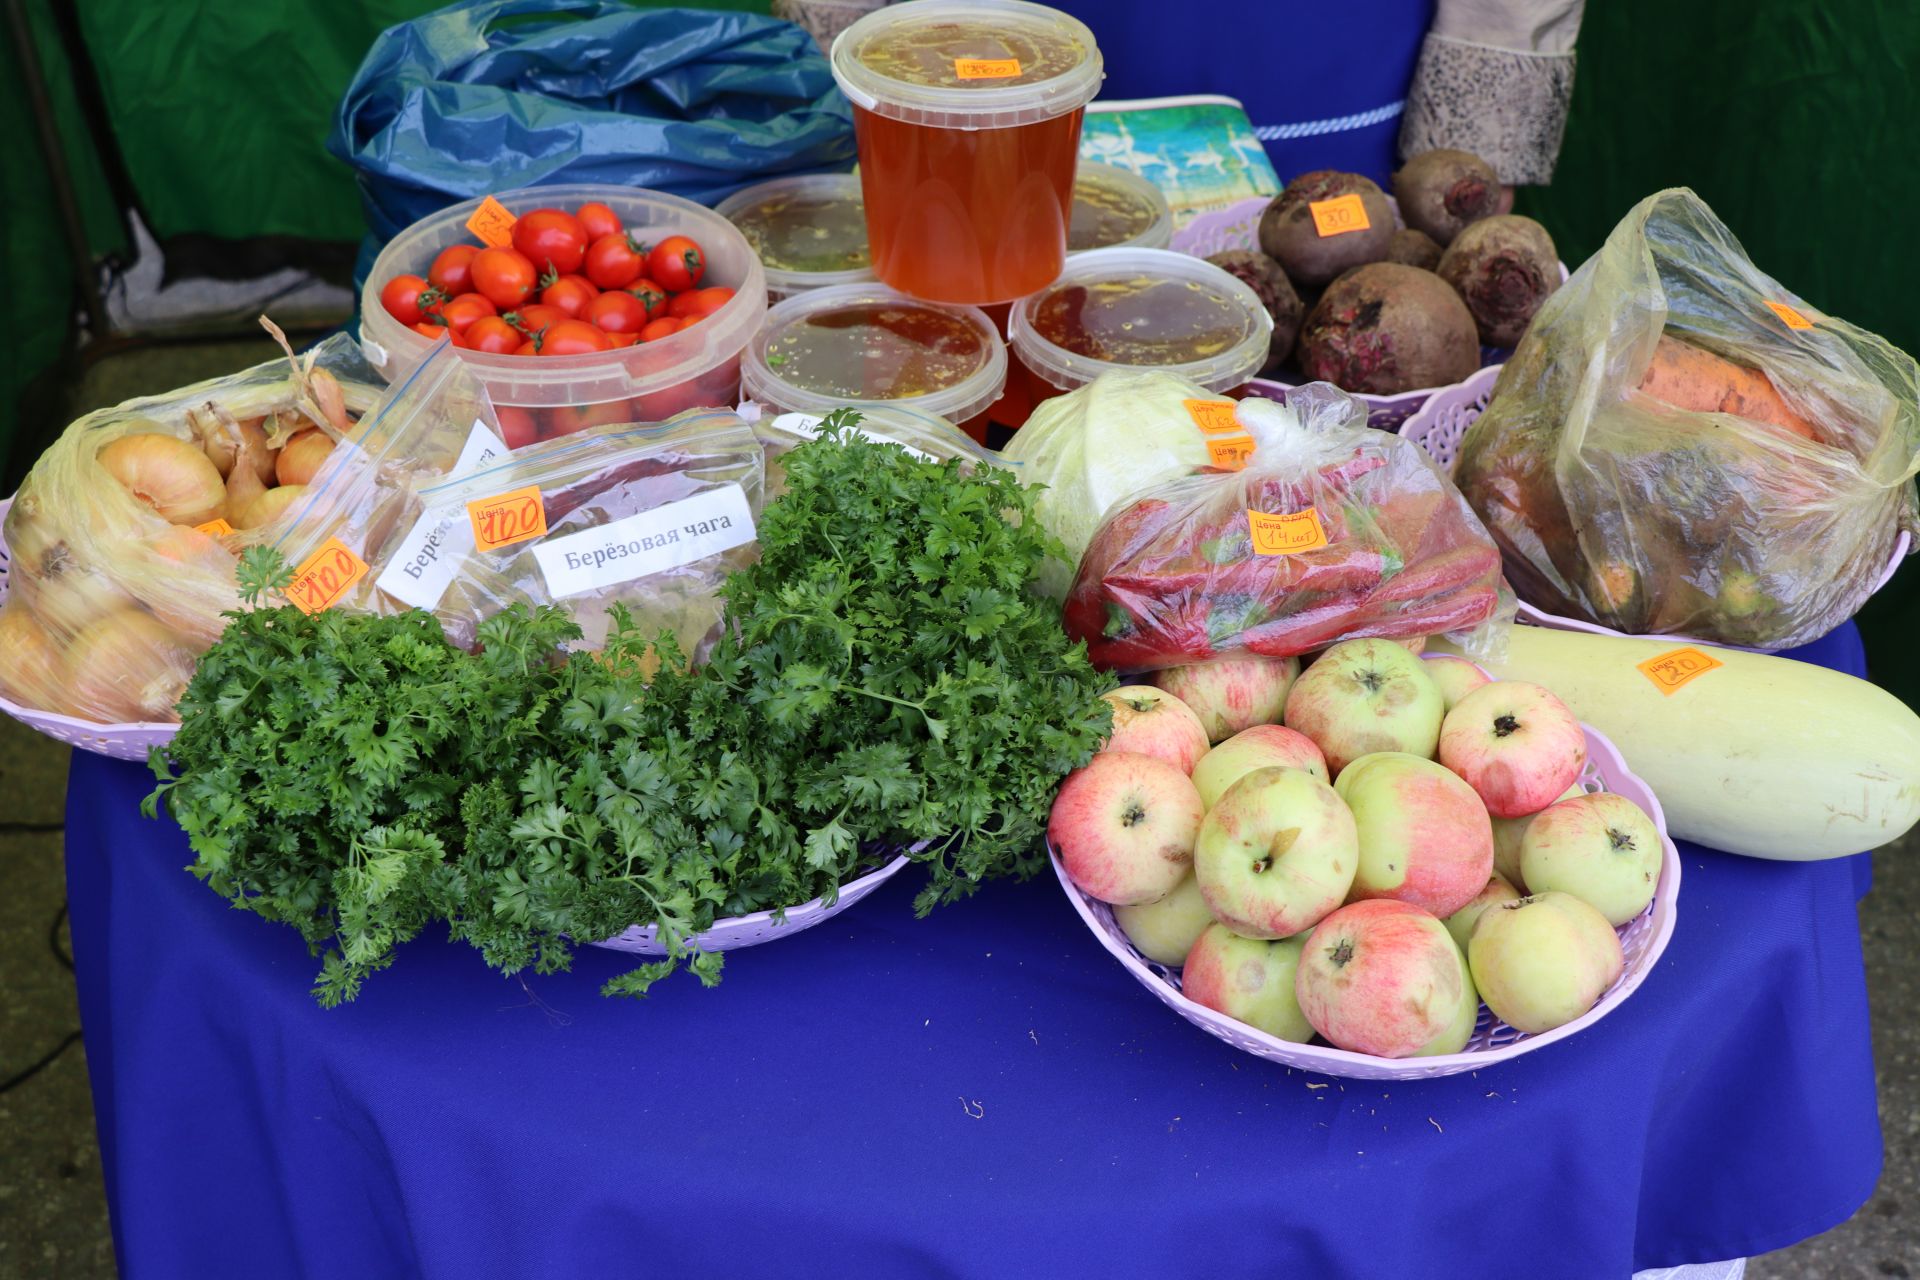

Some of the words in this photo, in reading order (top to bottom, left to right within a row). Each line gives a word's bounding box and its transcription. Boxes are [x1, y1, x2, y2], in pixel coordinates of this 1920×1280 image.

[477, 507, 505, 521] Цена
[483, 498, 540, 545] 100
[1255, 519, 1281, 530] Цена
[564, 527, 681, 571] Берёзовая
[683, 514, 733, 538] чага
[291, 571, 318, 595] Цена
[307, 549, 355, 605] 100
[1649, 659, 1675, 673] Цена
[1664, 658, 1698, 681] 20
